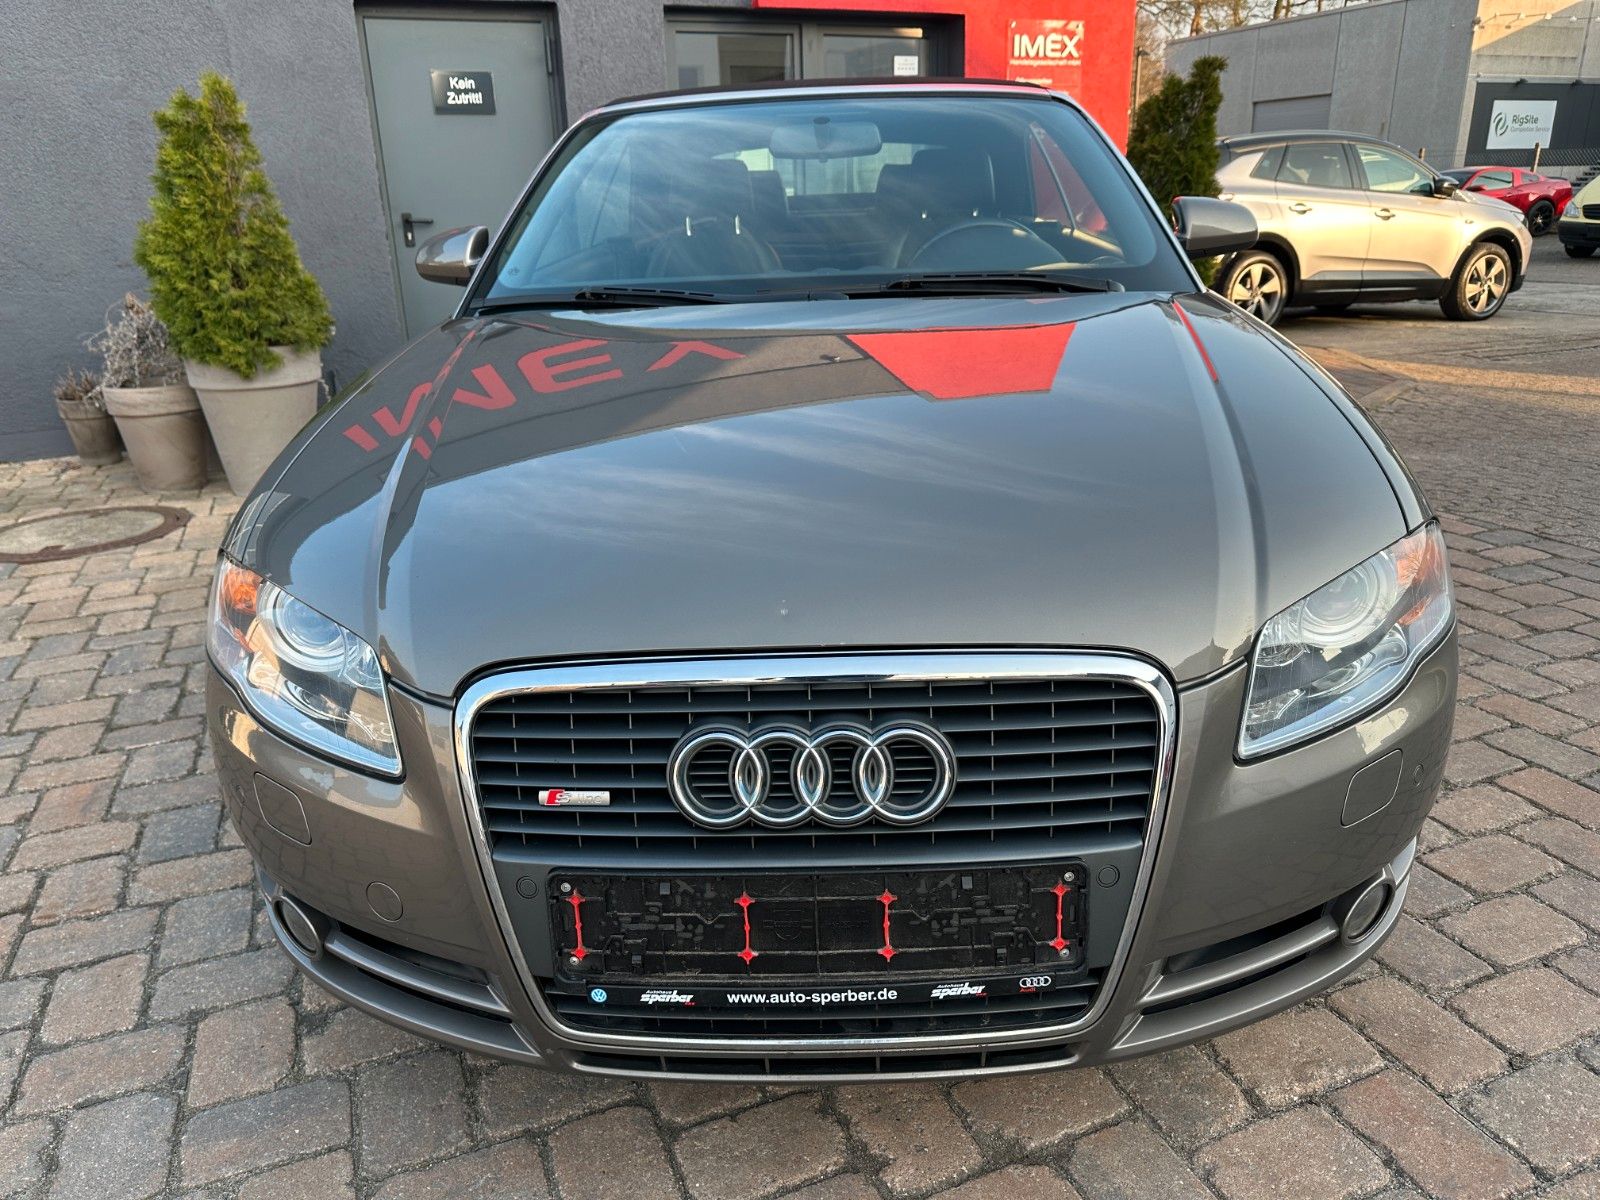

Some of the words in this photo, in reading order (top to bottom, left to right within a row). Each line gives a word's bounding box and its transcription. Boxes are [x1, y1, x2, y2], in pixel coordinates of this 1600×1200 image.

[1013, 33, 1081, 58] IMEX
[449, 76, 475, 89] Kein
[447, 91, 483, 104] Zutritt!
[1512, 114, 1538, 126] RigSite
[727, 988, 898, 1006] www.auto-sperber.de
